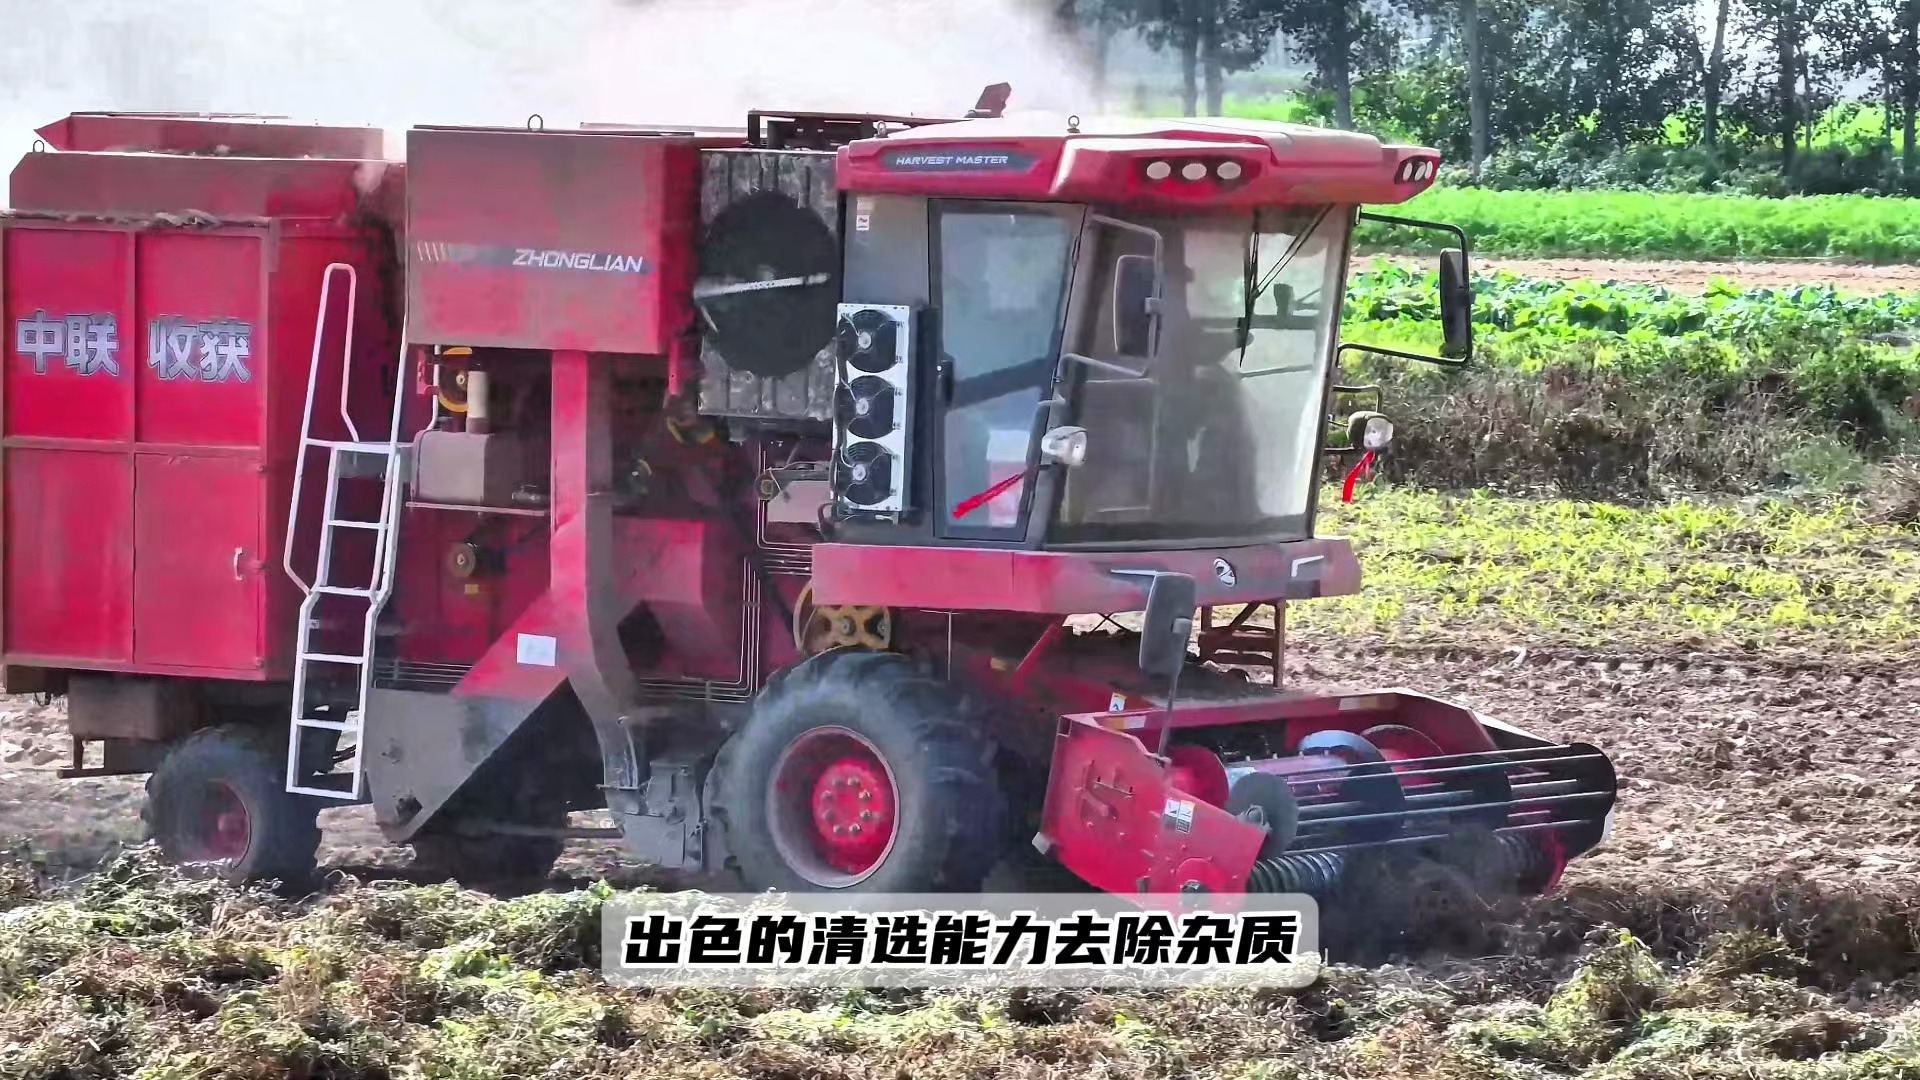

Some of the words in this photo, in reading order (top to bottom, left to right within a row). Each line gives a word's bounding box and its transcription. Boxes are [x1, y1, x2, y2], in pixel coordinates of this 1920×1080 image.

[896, 156, 953, 165] HARVEST
[955, 155, 1008, 164] MASTER
[512, 248, 643, 273] ZHONGLIAN
[16, 309, 119, 376] 中联
[148, 314, 250, 382] 收获
